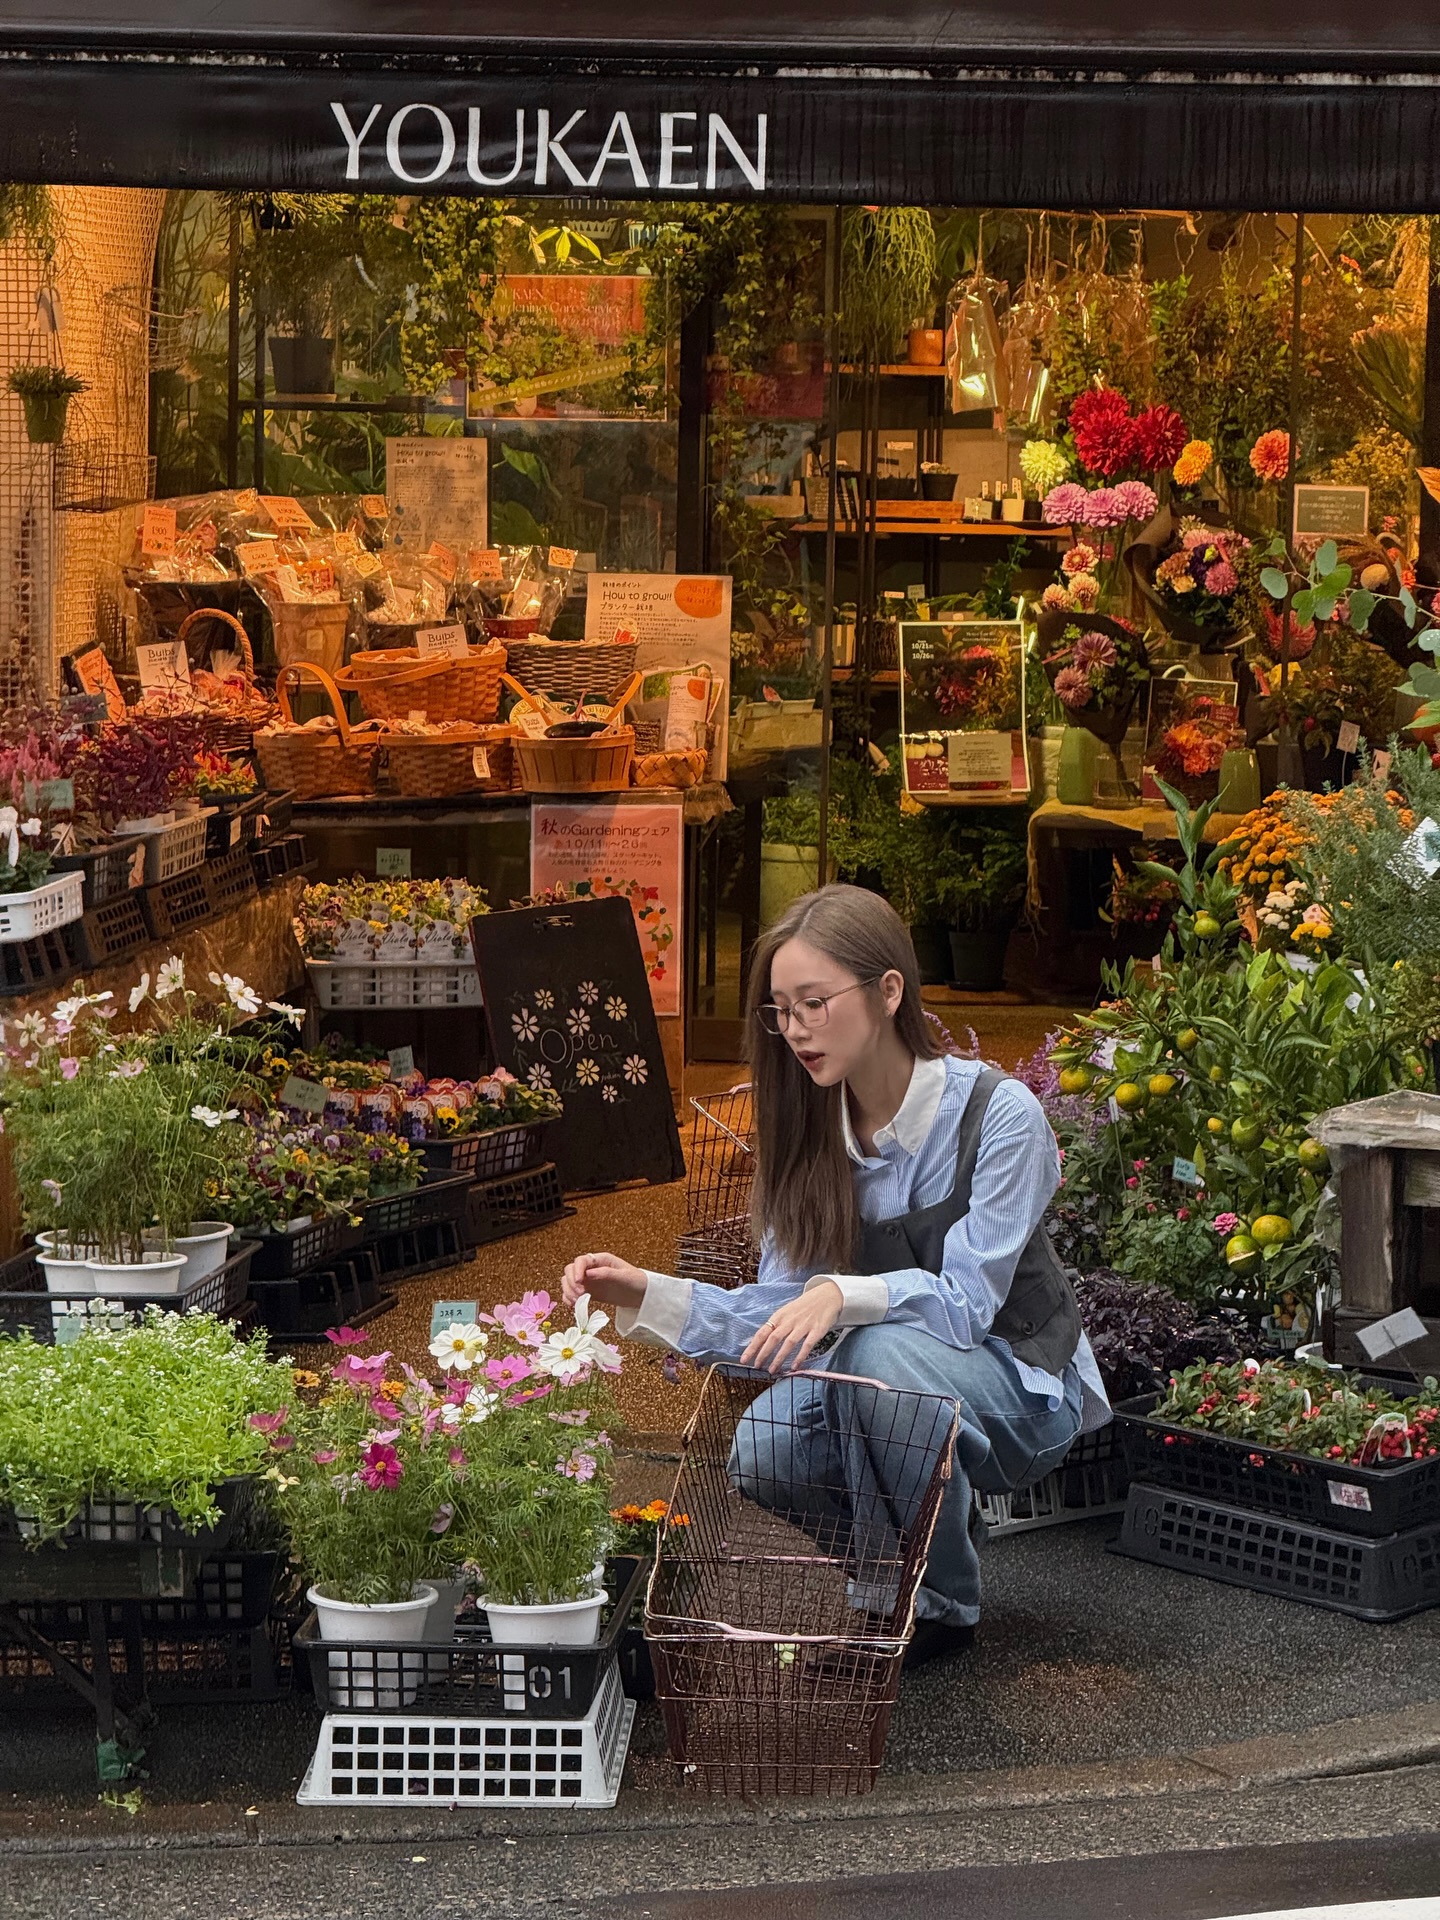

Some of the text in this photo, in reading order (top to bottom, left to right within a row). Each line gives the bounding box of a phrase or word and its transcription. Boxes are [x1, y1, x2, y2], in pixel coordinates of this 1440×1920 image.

[329, 102, 768, 191] YOUKAEN
[602, 591, 626, 601] How
[628, 592, 640, 601] to
[427, 631, 456, 643] Bulbs
[147, 648, 176, 659] Bulbs
[382, 931, 409, 945] Viola
[425, 930, 451, 944] Viola
[539, 1028, 619, 1069] Open
[528, 1664, 571, 1699] 01
